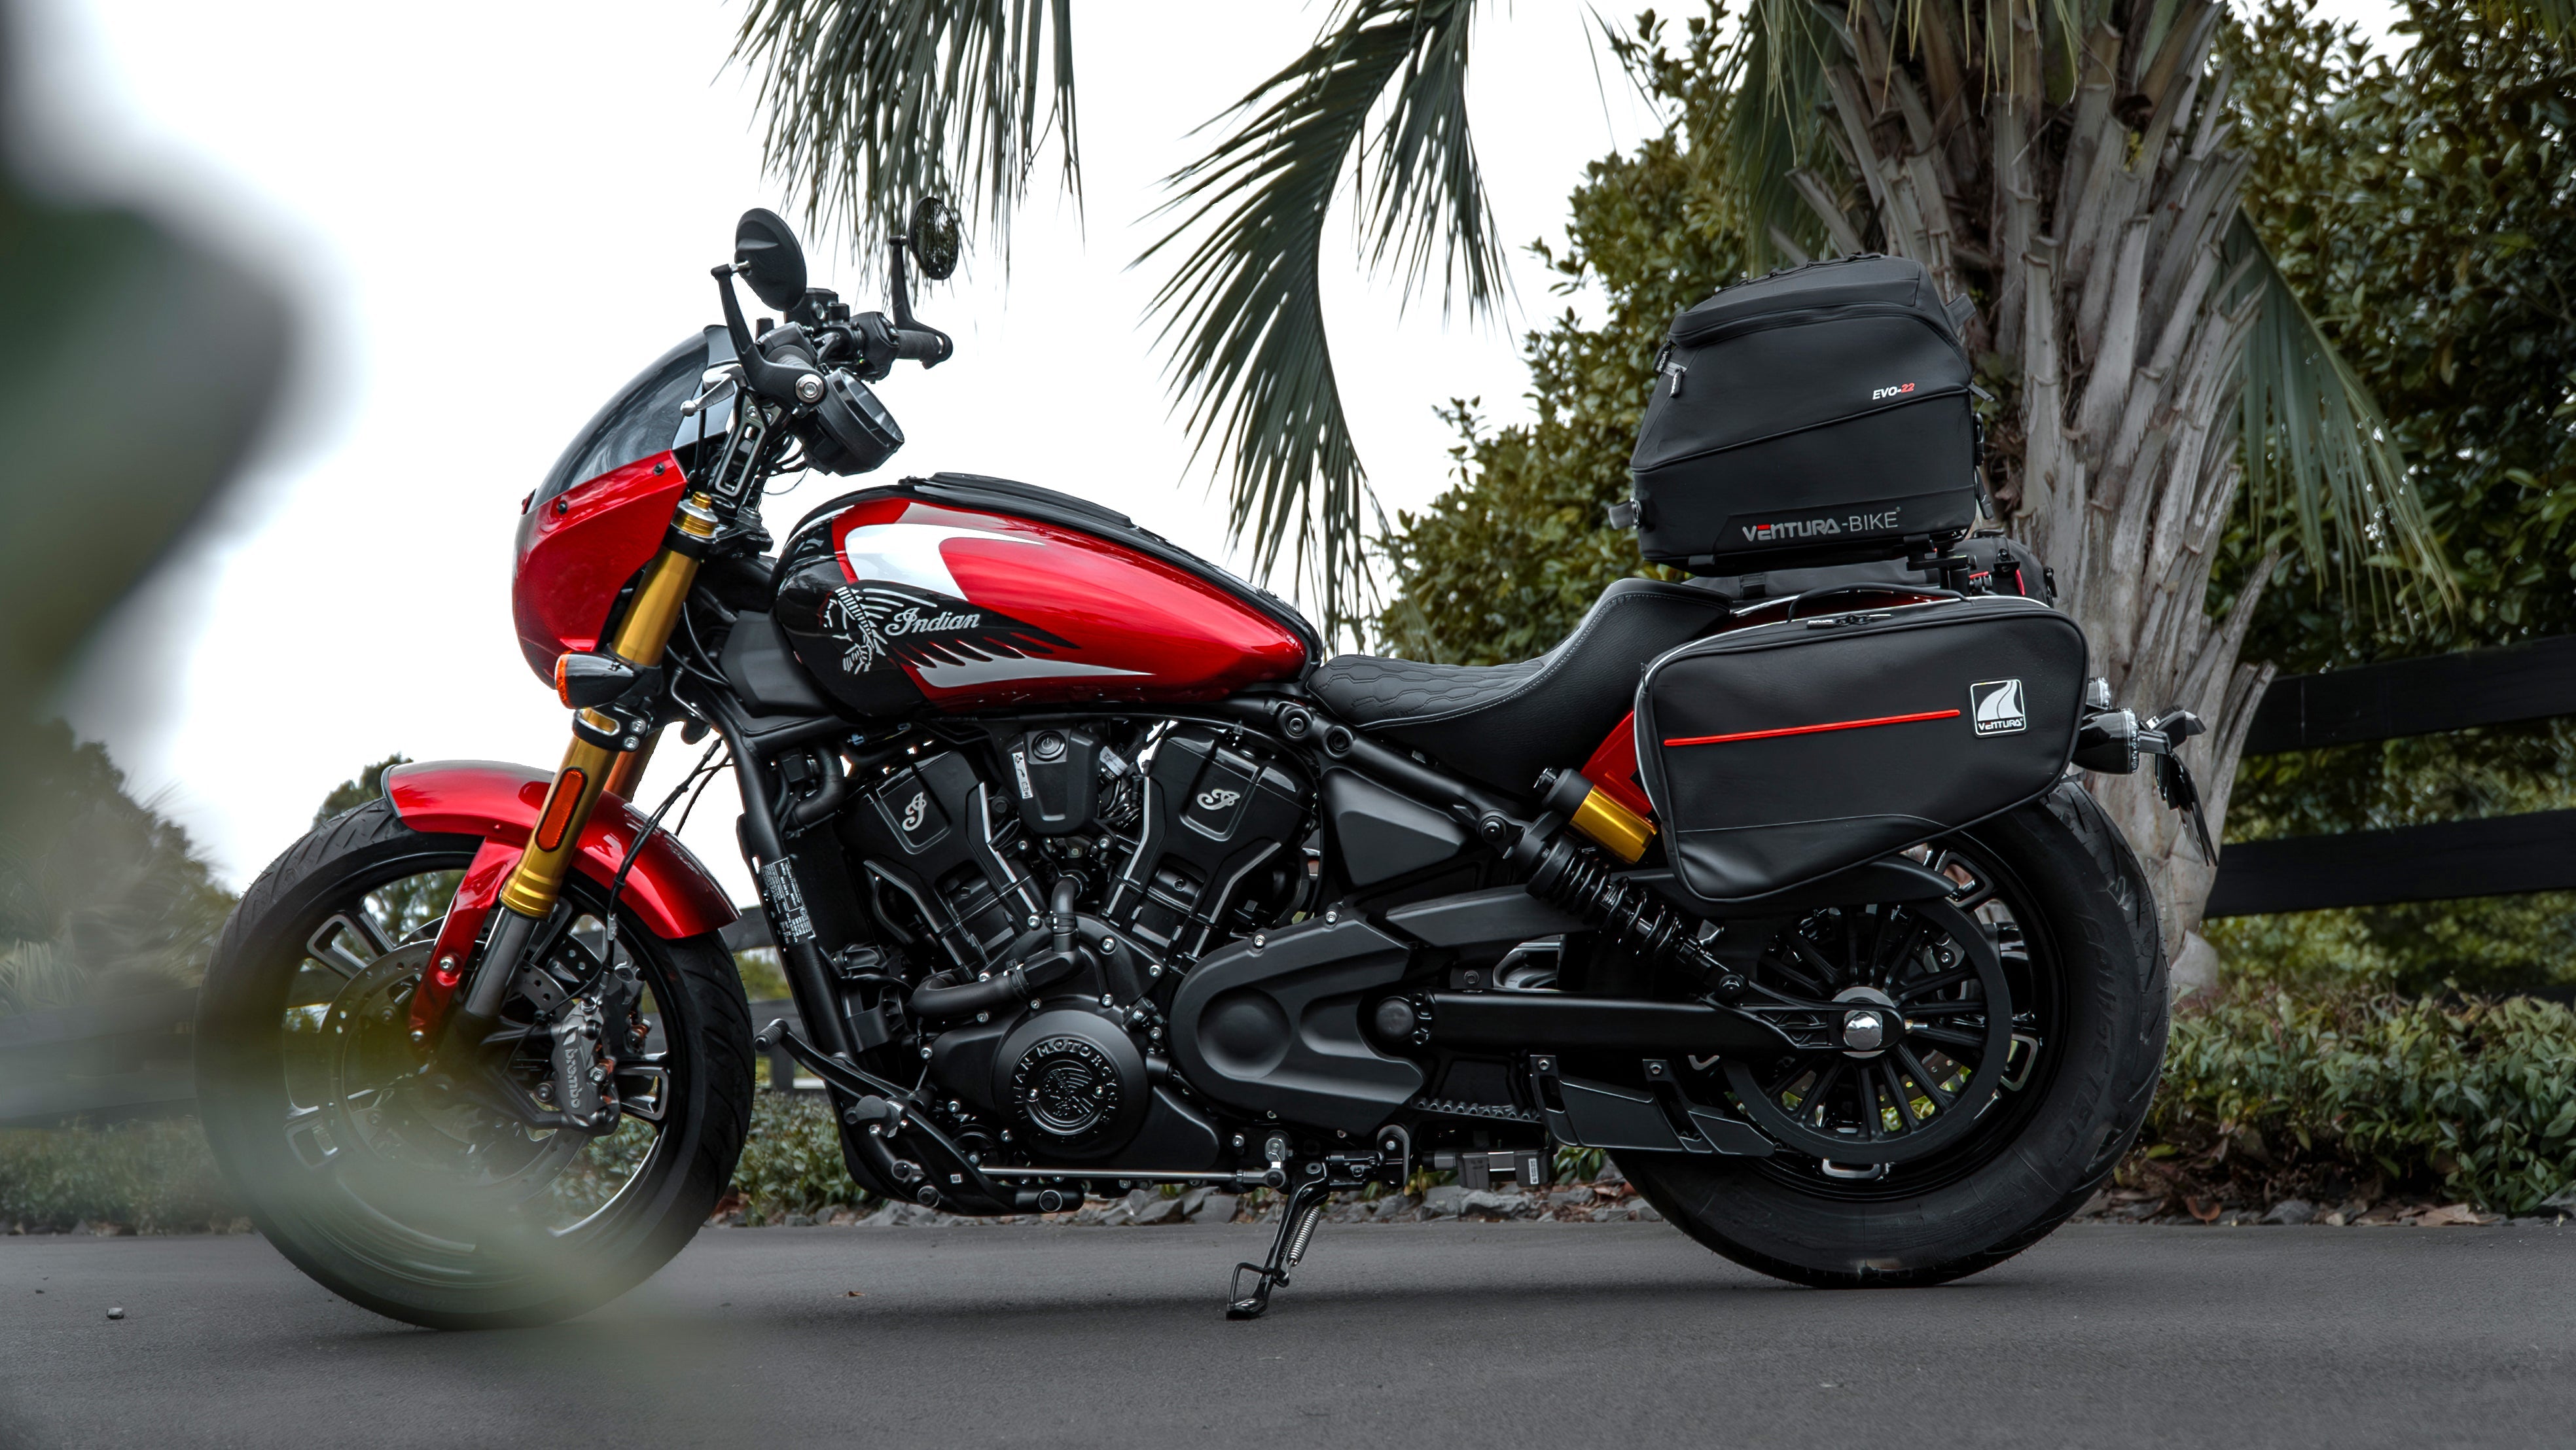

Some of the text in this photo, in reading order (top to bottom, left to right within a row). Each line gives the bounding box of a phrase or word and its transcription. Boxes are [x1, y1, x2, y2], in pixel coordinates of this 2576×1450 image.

[1872, 383, 1915, 400] EVO-22
[884, 607, 980, 636] Indian
[565, 1048, 583, 1108] brembo
